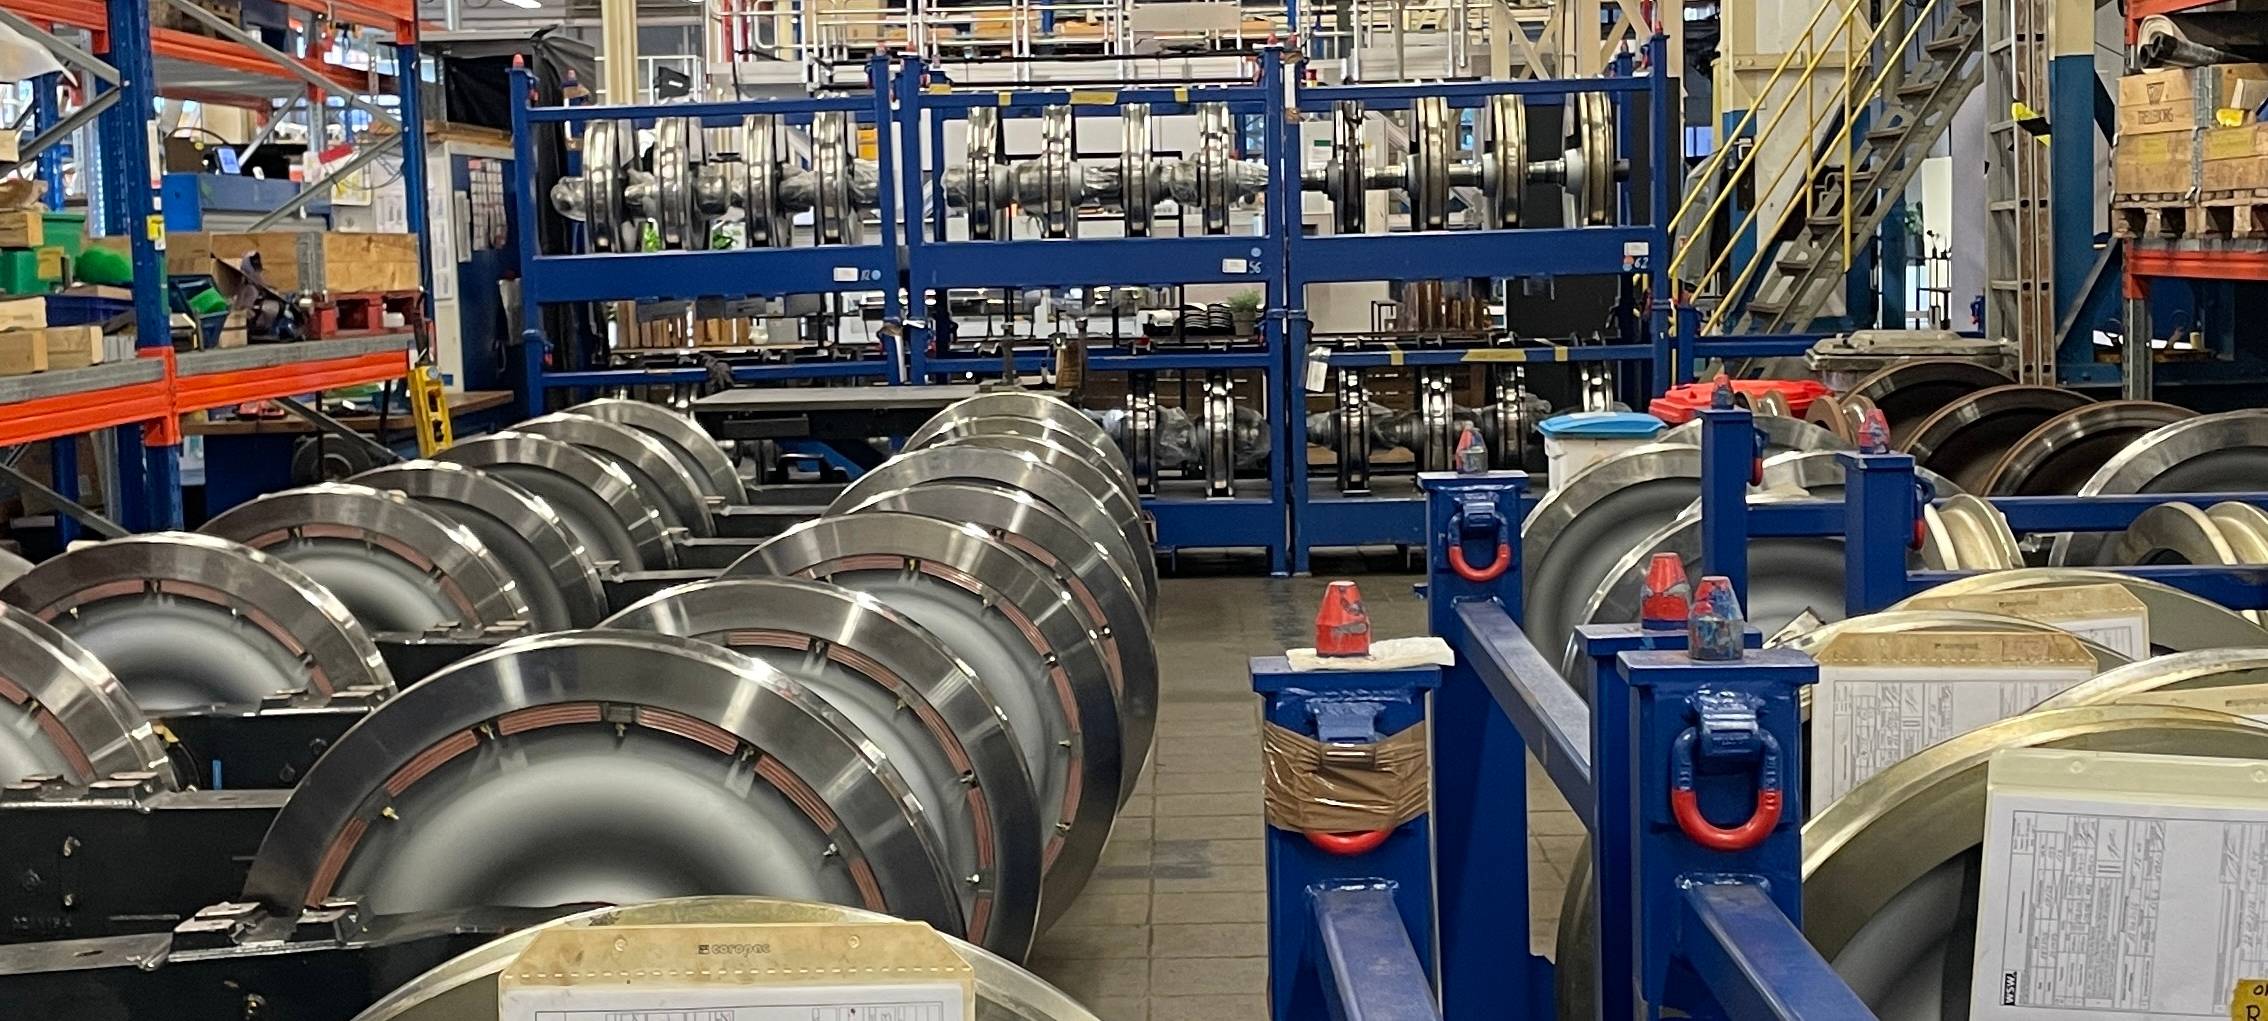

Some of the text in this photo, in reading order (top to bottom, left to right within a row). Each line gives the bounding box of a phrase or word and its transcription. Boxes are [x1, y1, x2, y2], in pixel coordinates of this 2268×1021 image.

[1249, 260, 1262, 274] 56
[1634, 256, 1649, 269] 62
[711, 943, 770, 958] coropac
[2004, 975, 2017, 1004] WSW
